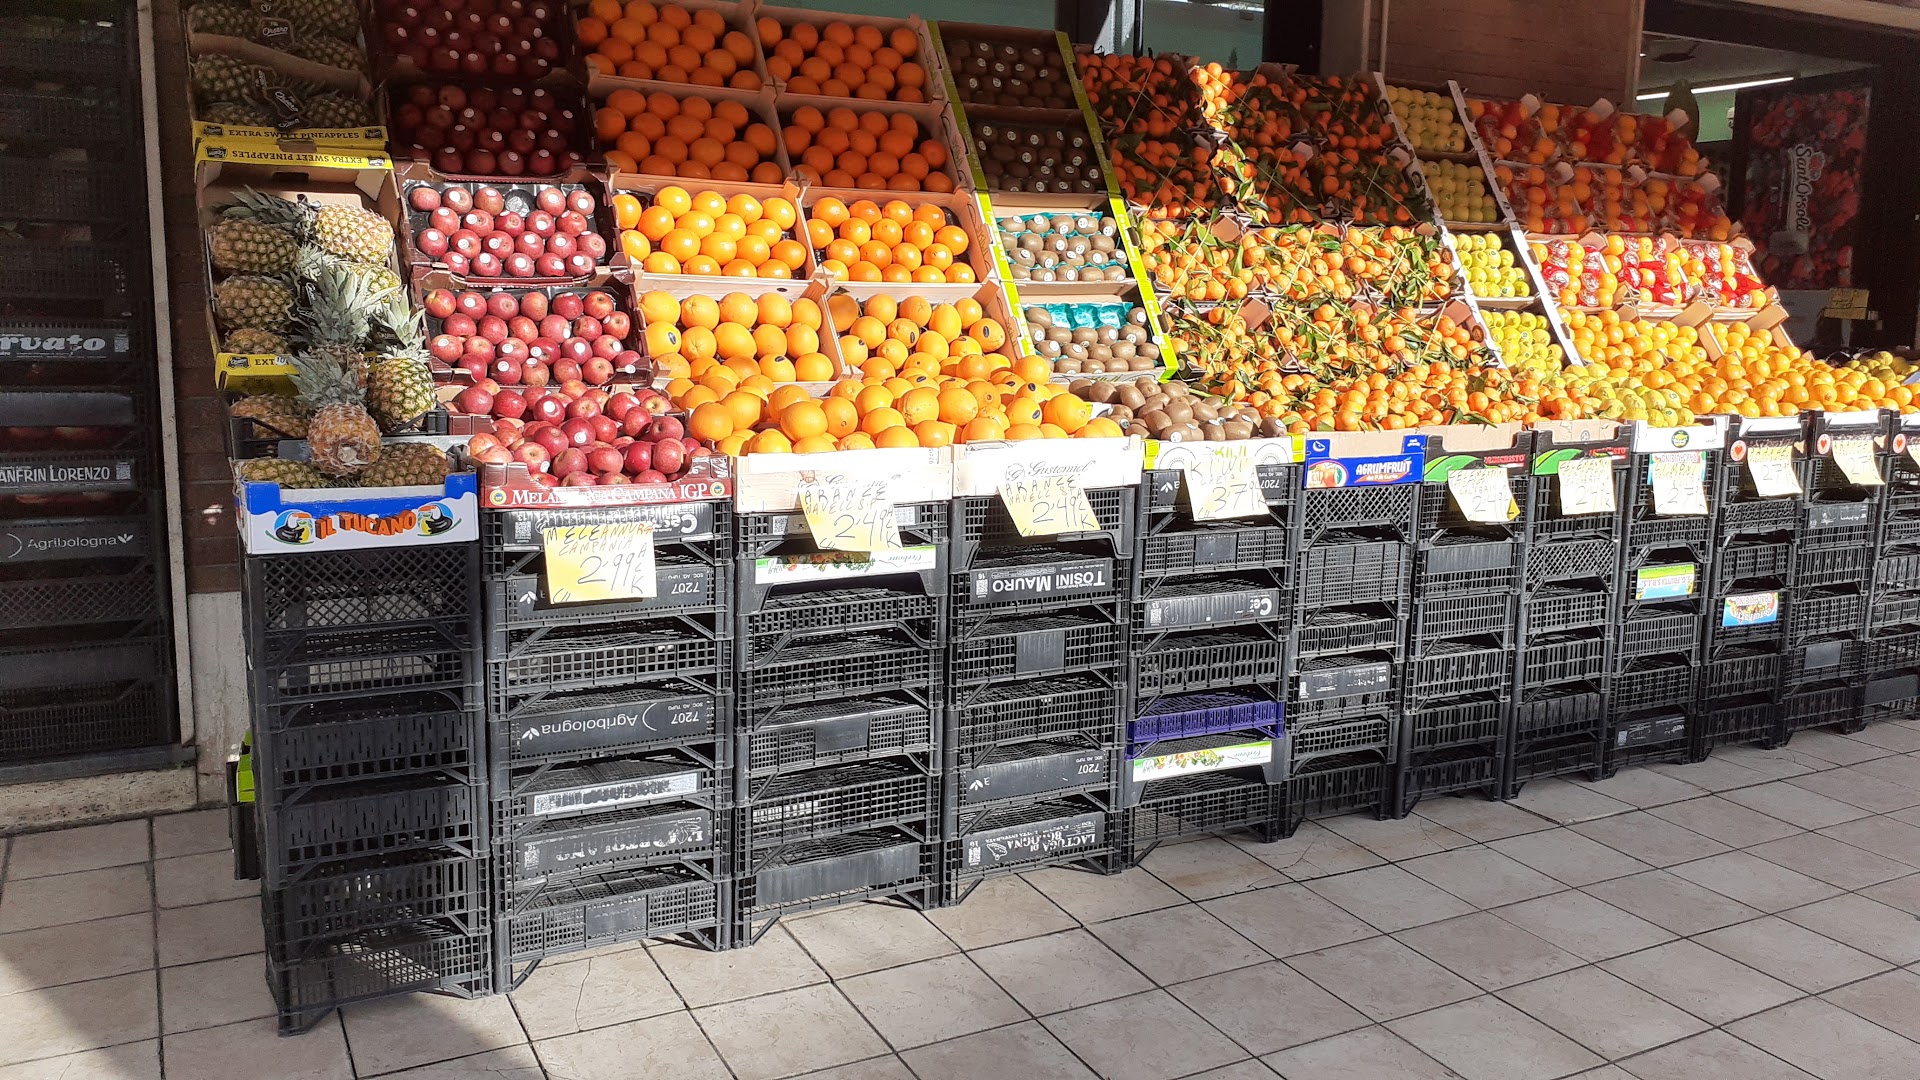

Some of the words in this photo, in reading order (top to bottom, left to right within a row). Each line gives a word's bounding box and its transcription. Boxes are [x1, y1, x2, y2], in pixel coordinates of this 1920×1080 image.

[229, 129, 261, 137] EXTRA
[231, 150, 294, 160] PINEAPPLES
[294, 152, 330, 162] SWEET
[332, 155, 363, 163] EXTRA
[50, 465, 111, 482] LORENZO
[1356, 460, 1412, 476] AGRUMFRUIT
[611, 486, 677, 502] CAMPANA
[680, 482, 709, 499] IGP
[1004, 475, 1078, 496] ARANCE
[804, 486, 886, 502] ARANCE
[315, 516, 337, 540] IL
[335, 510, 417, 536] TUCANO
[27, 537, 118, 551] Agribologna
[558, 535, 633, 557] CAMPANIA
[992, 575, 1052, 593] MAURO
[1055, 570, 1106, 589] TOSINI
[671, 582, 700, 595] 7207
[540, 713, 639, 735] Agribologna
[670, 710, 700, 725] 7207
[1077, 763, 1100, 775] 7207
